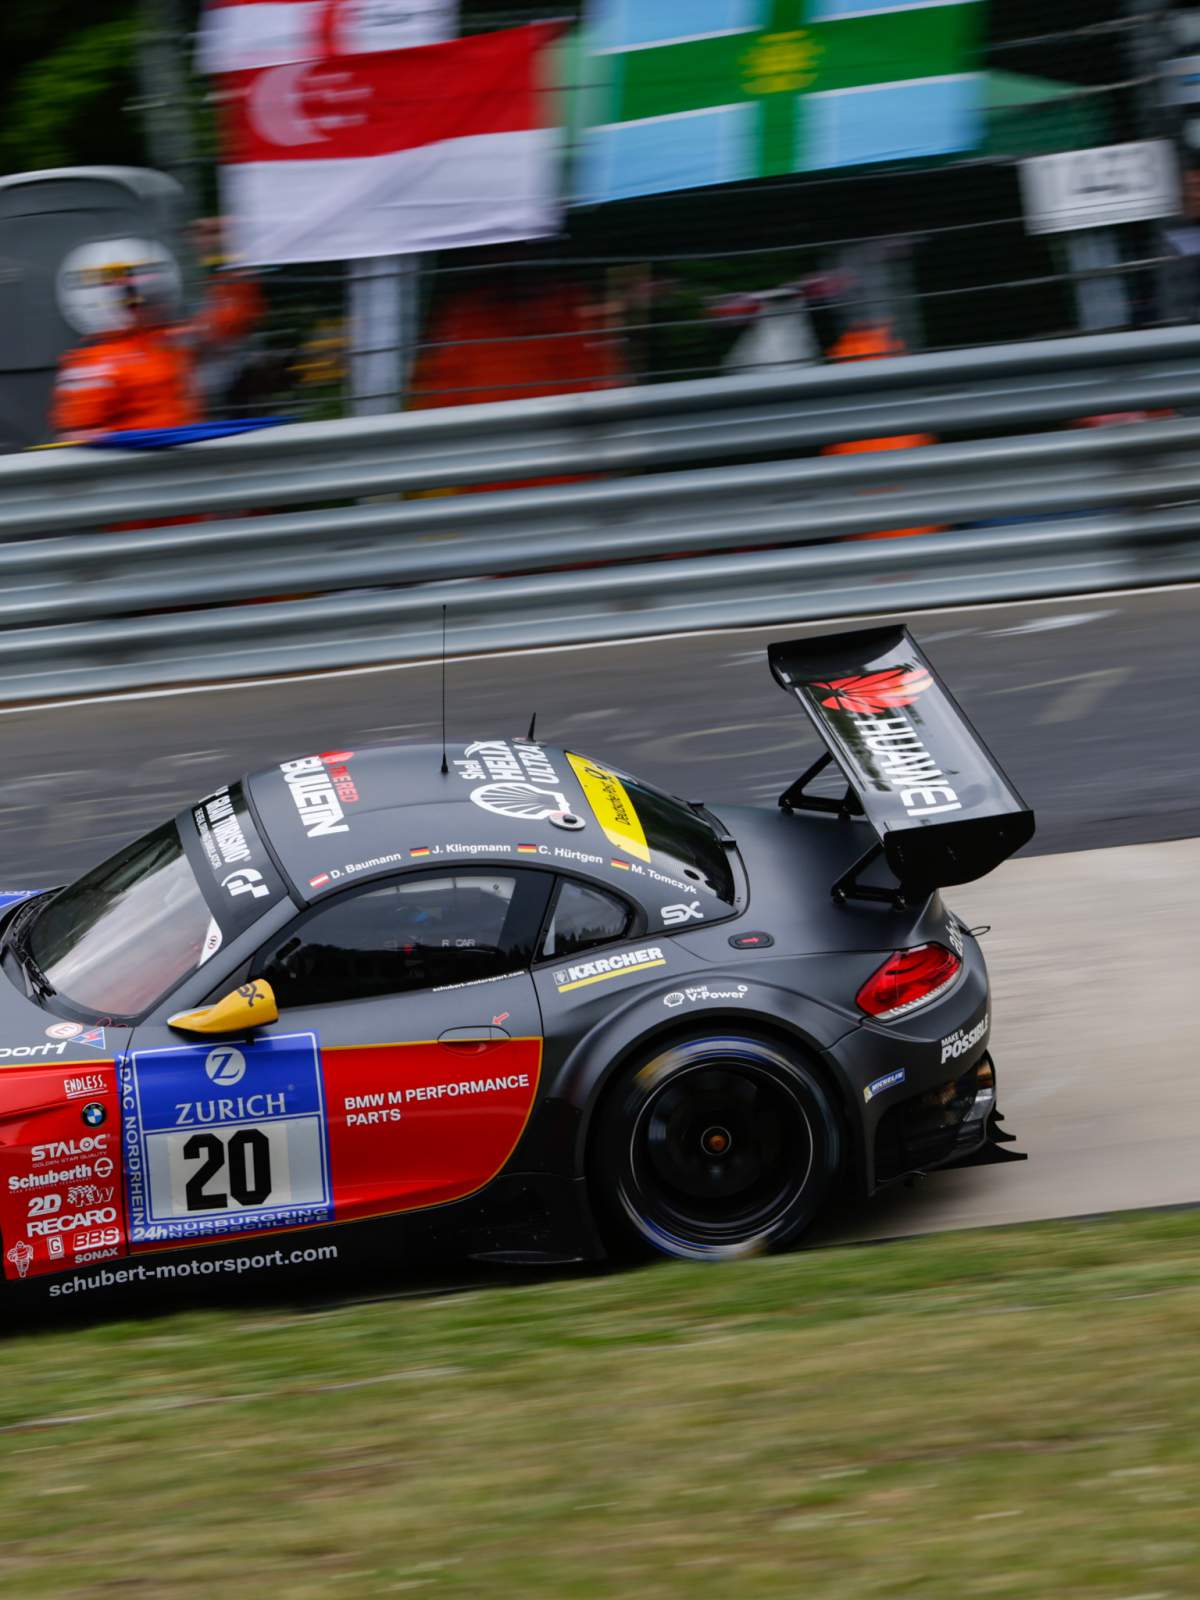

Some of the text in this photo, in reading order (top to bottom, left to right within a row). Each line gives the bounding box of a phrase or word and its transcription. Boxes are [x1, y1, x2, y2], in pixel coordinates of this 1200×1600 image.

[464, 741, 525, 780] HELIX
[513, 744, 559, 783] ULTRA
[855, 717, 962, 817] HUAWEI
[432, 843, 511, 855] J. Klingmann
[538, 845, 604, 865] C. Hürtgen
[330, 852, 402, 880] D. Baumann
[630, 864, 698, 895] M. Tomczyk
[687, 991, 746, 1003] V-Power
[941, 1013, 989, 1065] POSSIBLE
[344, 1074, 529, 1110] BMW M PERFORMANCE
[175, 1092, 286, 1125] ZURICH
[346, 1108, 401, 1127] PARTS
[31, 1133, 108, 1162] STALOC
[119, 1054, 145, 1225] ADAC NORDRHEIN
[8, 1164, 93, 1190] Schuberth
[183, 1128, 273, 1212] 20
[26, 1207, 117, 1238] RECARO
[133, 1208, 329, 1241] 24h NÜRBURGRING
[169, 1215, 329, 1239] NORDSCHLEIFE
[73, 1226, 120, 1251] BBS
[49, 1246, 339, 1296] schubert-motorsport.com
[74, 1247, 119, 1264] SONAX
